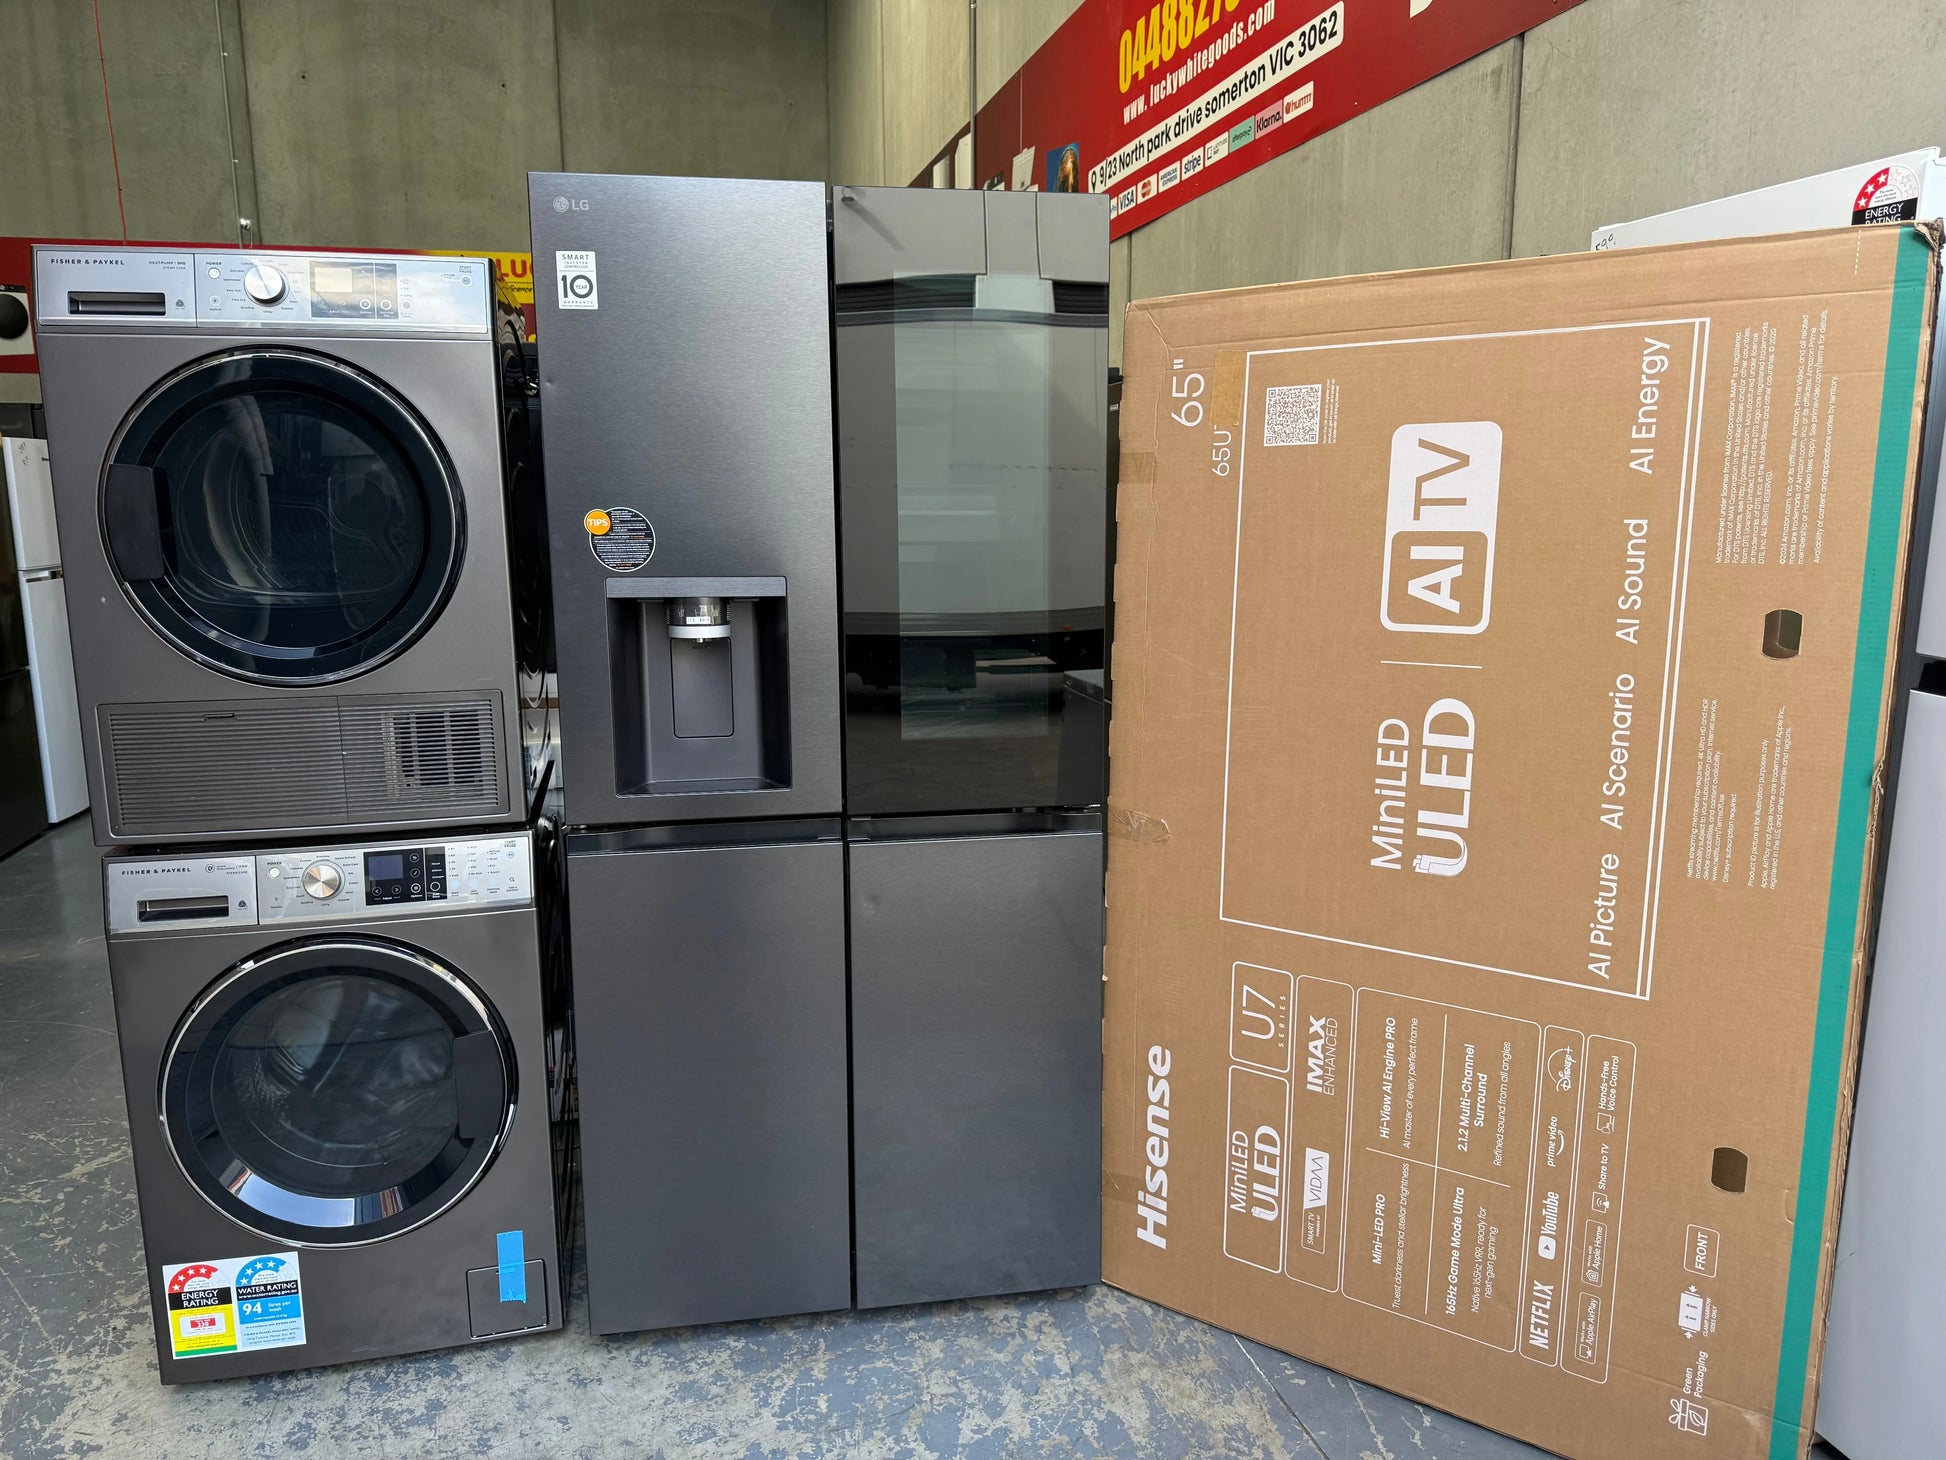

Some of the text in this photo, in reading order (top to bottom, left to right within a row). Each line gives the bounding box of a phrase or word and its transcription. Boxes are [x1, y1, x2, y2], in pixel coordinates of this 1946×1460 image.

[1123, 0, 1275, 125] www. luckywhitegoods.com
[1099, 157, 1117, 187] 9/23
[1119, 140, 1145, 173] North
[1147, 123, 1172, 162] park
[1174, 106, 1203, 139] drive
[1205, 64, 1266, 119] somerton
[1269, 41, 1294, 76] VIC
[1298, 10, 1338, 59] 3062
[1256, 110, 1282, 133] Klarna.
[1184, 155, 1202, 175] stripe
[571, 199, 590, 211] LG
[1119, 189, 1135, 210] VISA
[1865, 202, 1904, 220] ENERGY
[561, 253, 590, 261] SMART
[560, 274, 594, 299] 10
[1629, 337, 1669, 475] AI Energy
[1211, 424, 1232, 477] 65U
[587, 518, 609, 527] TIPS
[1406, 437, 1471, 615] AI TV
[1615, 519, 1648, 645] AI Sound
[1600, 673, 1635, 830] AI Scenario
[1370, 718, 1409, 871] MiniLED
[1413, 699, 1476, 876] ULED
[1587, 853, 1620, 980] AI Picture
[1241, 984, 1276, 1040] U7
[1277, 995, 1287, 1048] SERIES
[1306, 1014, 1326, 1093] IMAX
[1323, 1018, 1338, 1096] ENHANCED
[1379, 1017, 1396, 1139] Hi-View AI Engine PRO
[1402, 1017, 1419, 1149] AI master of every perfect frame
[1457, 1043, 1475, 1152] 2.1.2 Multi-Channel
[1473, 1072, 1488, 1128] Surround
[1493, 1041, 1512, 1167] Refined sound from all angles
[1598, 1060, 1610, 1110] Hands-Free
[1607, 1055, 1620, 1111] Voice Control
[1136, 1045, 1171, 1250] Hisense
[1547, 1116, 1559, 1168] prime video
[1597, 1143, 1609, 1190] Share to TV
[1230, 1130, 1249, 1213] MiniLED
[1250, 1125, 1281, 1222] ULED
[1307, 1212, 1315, 1245] SMART TV
[1372, 1193, 1386, 1265] Mini-LED PRO
[1392, 1162, 1410, 1308] Truest darkness and stellar brightness
[1476, 1219, 1487, 1245] ready
[1477, 1206, 1487, 1220] for
[1540, 1191, 1559, 1236] YouTube
[1445, 1186, 1465, 1315] 165Hz Game Mode Ultra
[1484, 1226, 1499, 1299] next-gen gaming
[1592, 1225, 1603, 1270] Apple Home
[1694, 1231, 1708, 1271] FRONT
[181, 1289, 219, 1301] ENERGY
[237, 1281, 297, 1294] WATER RATING
[1471, 1286, 1481, 1313] Native
[1472, 1263, 1483, 1286] 165Hz
[183, 1297, 219, 1308] RATING
[242, 1301, 263, 1316] 94
[1528, 1279, 1554, 1350] NETFLIX
[1586, 1297, 1601, 1346] Apple AirPlay
[1682, 1367, 1693, 1395] Green
[1693, 1350, 1709, 1399] Packaging
